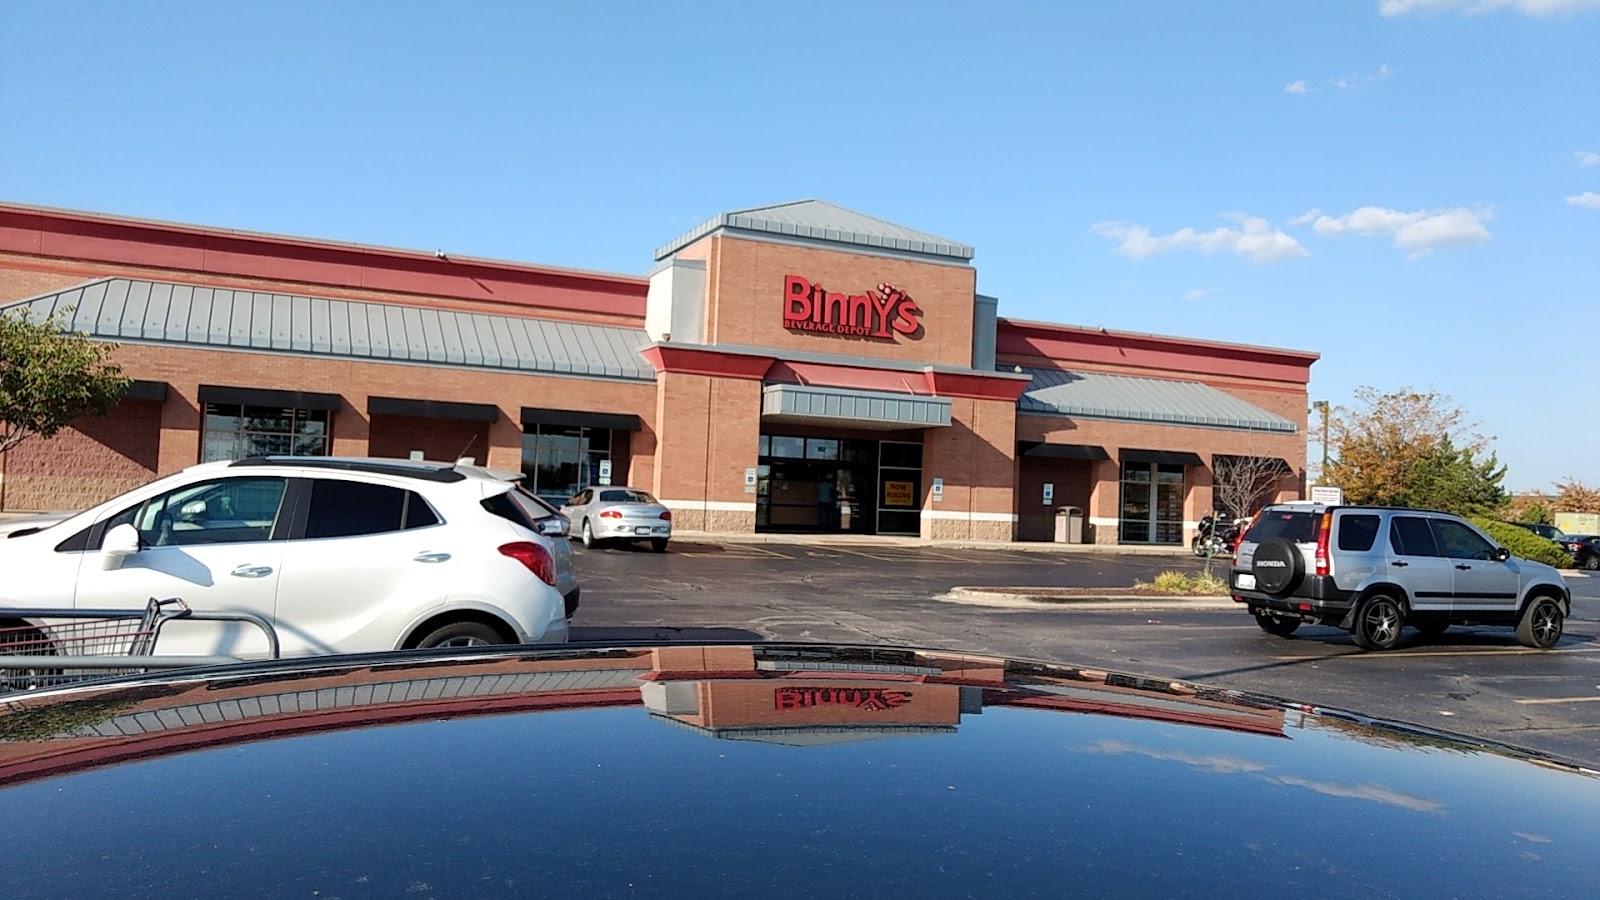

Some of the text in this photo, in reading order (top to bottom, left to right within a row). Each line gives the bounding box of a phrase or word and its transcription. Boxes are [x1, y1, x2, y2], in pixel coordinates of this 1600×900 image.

[784, 320, 871, 336] BEVERAGE DEPOT
[890, 483, 907, 491] NOW
[887, 491, 912, 499] HIRING
[1256, 560, 1287, 568] HONDA
